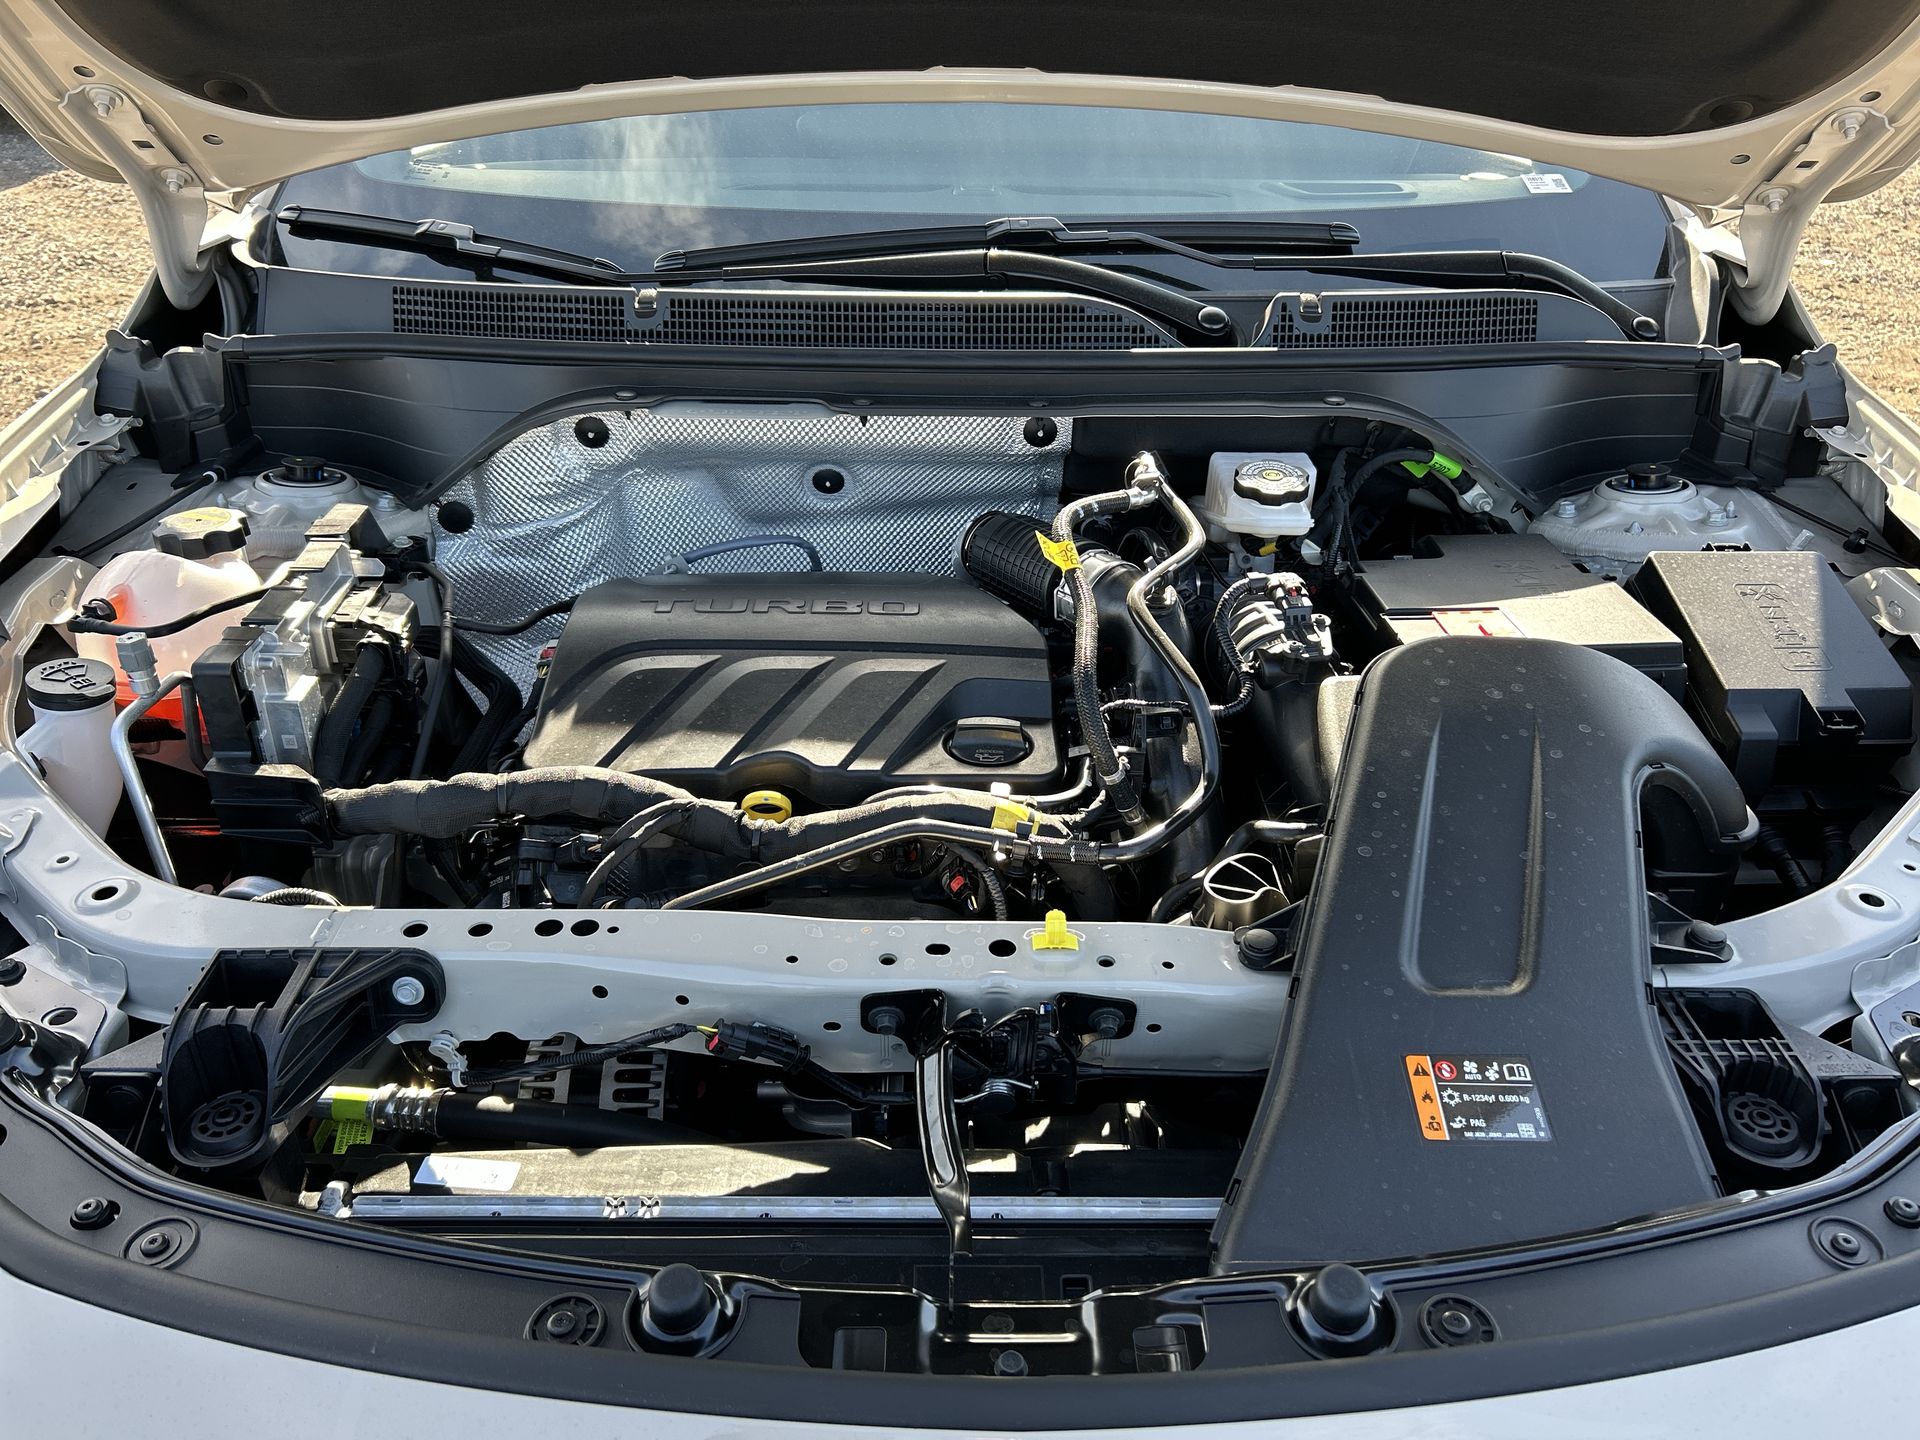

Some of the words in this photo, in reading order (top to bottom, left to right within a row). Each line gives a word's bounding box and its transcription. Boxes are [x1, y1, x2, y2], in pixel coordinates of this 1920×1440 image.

[640, 598, 921, 616] TURBO
[1464, 1073, 1482, 1081] AUTO
[1462, 1093, 1496, 1104] R-1234yf
[1498, 1094, 1519, 1102] 0.600
[1519, 1095, 1530, 1104] kg
[1469, 1118, 1487, 1127] PAG
